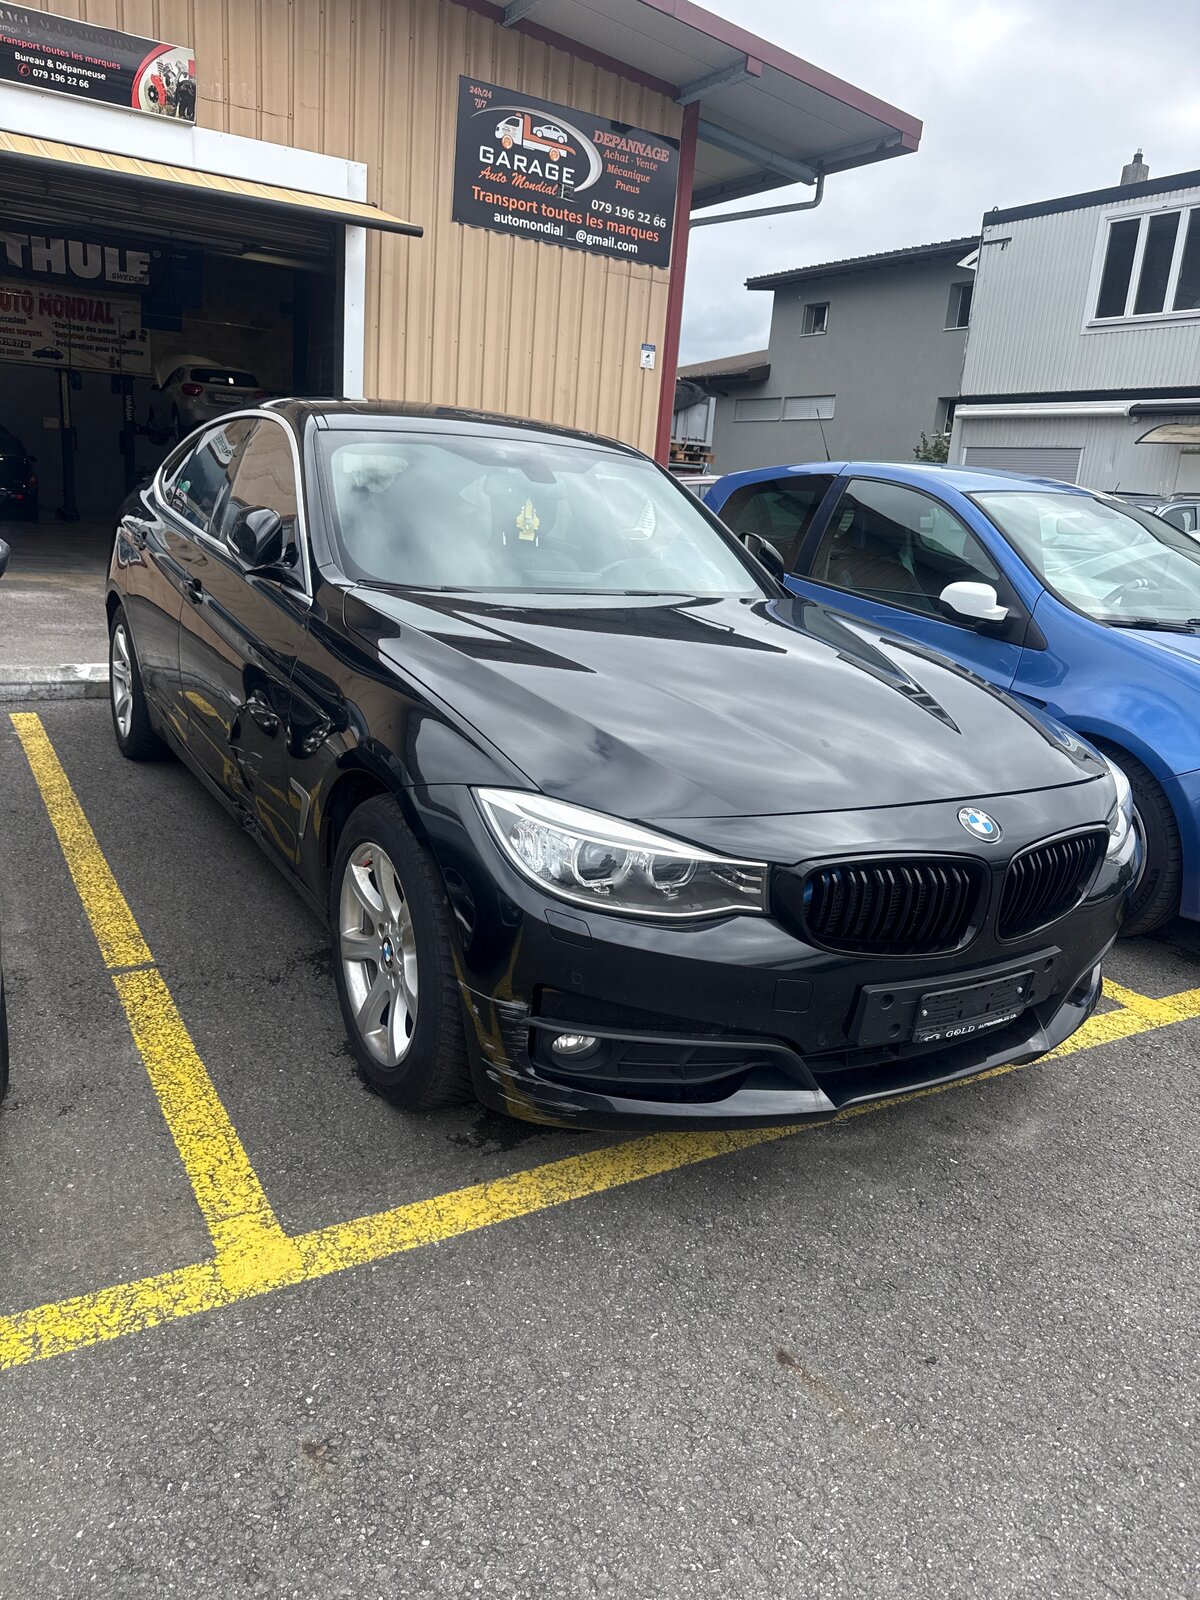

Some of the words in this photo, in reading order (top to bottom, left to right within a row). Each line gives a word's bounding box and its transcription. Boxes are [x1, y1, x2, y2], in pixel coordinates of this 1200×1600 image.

[14, 51, 45, 66] Bureau
[46, 59, 55, 69] &
[56, 61, 107, 81] Dépanneuse
[42, 44, 70, 58] toutes
[71, 50, 84, 61] les
[85, 56, 121, 71] marques
[32, 68, 49, 80] 079
[50, 72, 66, 83] 196
[67, 76, 78, 86] 22
[79, 78, 90, 89] 66
[592, 129, 670, 163] DEPANNAGE
[479, 144, 576, 185] GARAGE
[603, 149, 629, 164] Achat
[635, 156, 659, 172] Vente
[606, 160, 651, 184] Mécanique
[478, 166, 508, 184] Auto
[510, 172, 559, 197] Mondial
[614, 179, 641, 195] Pneus
[471, 184, 539, 215] Transport
[540, 201, 583, 225] toutes
[586, 212, 604, 230] les
[606, 217, 660, 243] marques
[493, 211, 564, 237] automondial
[591, 198, 613, 214] 079
[614, 205, 635, 221] 196
[637, 210, 651, 225] 22
[653, 214, 667, 229] 66
[0, 230, 151, 285] THULE
[111, 272, 145, 283] SWEDEN
[38, 292, 115, 325] MONDIAL
[945, 1025, 976, 1038] GOLD
